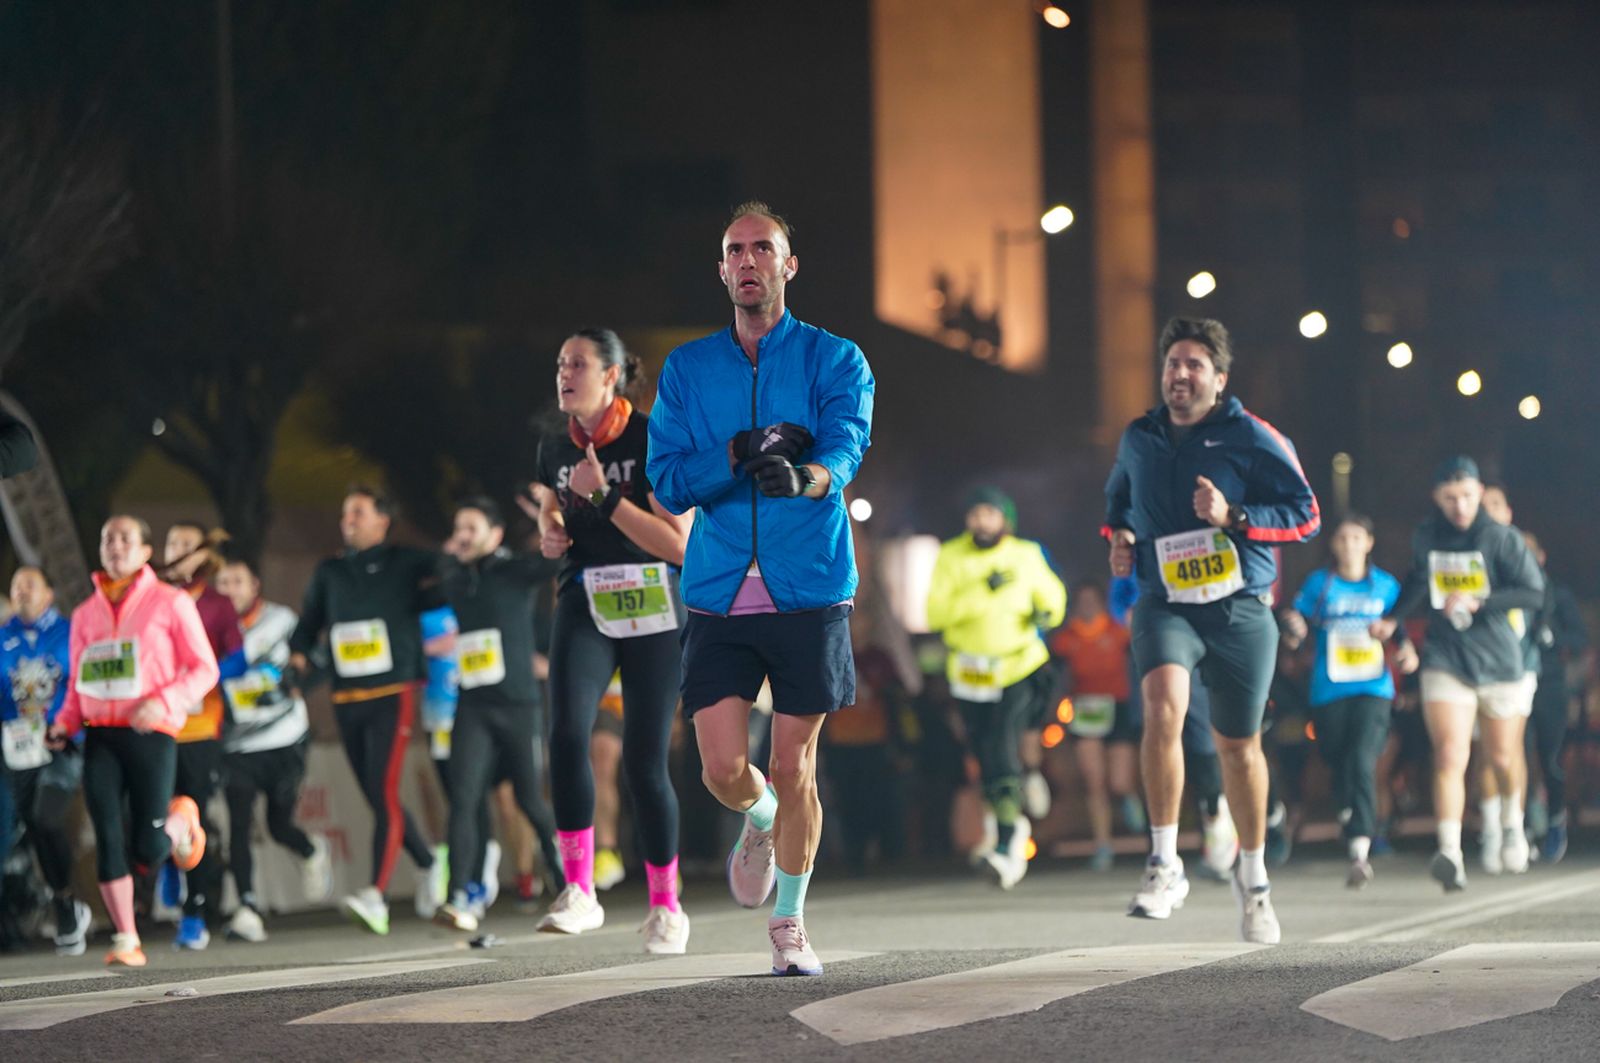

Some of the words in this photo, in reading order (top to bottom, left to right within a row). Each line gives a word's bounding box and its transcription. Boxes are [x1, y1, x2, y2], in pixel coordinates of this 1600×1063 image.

[557, 459, 636, 488] SAT
[1178, 556, 1223, 580] 4813
[612, 589, 644, 611] 757
